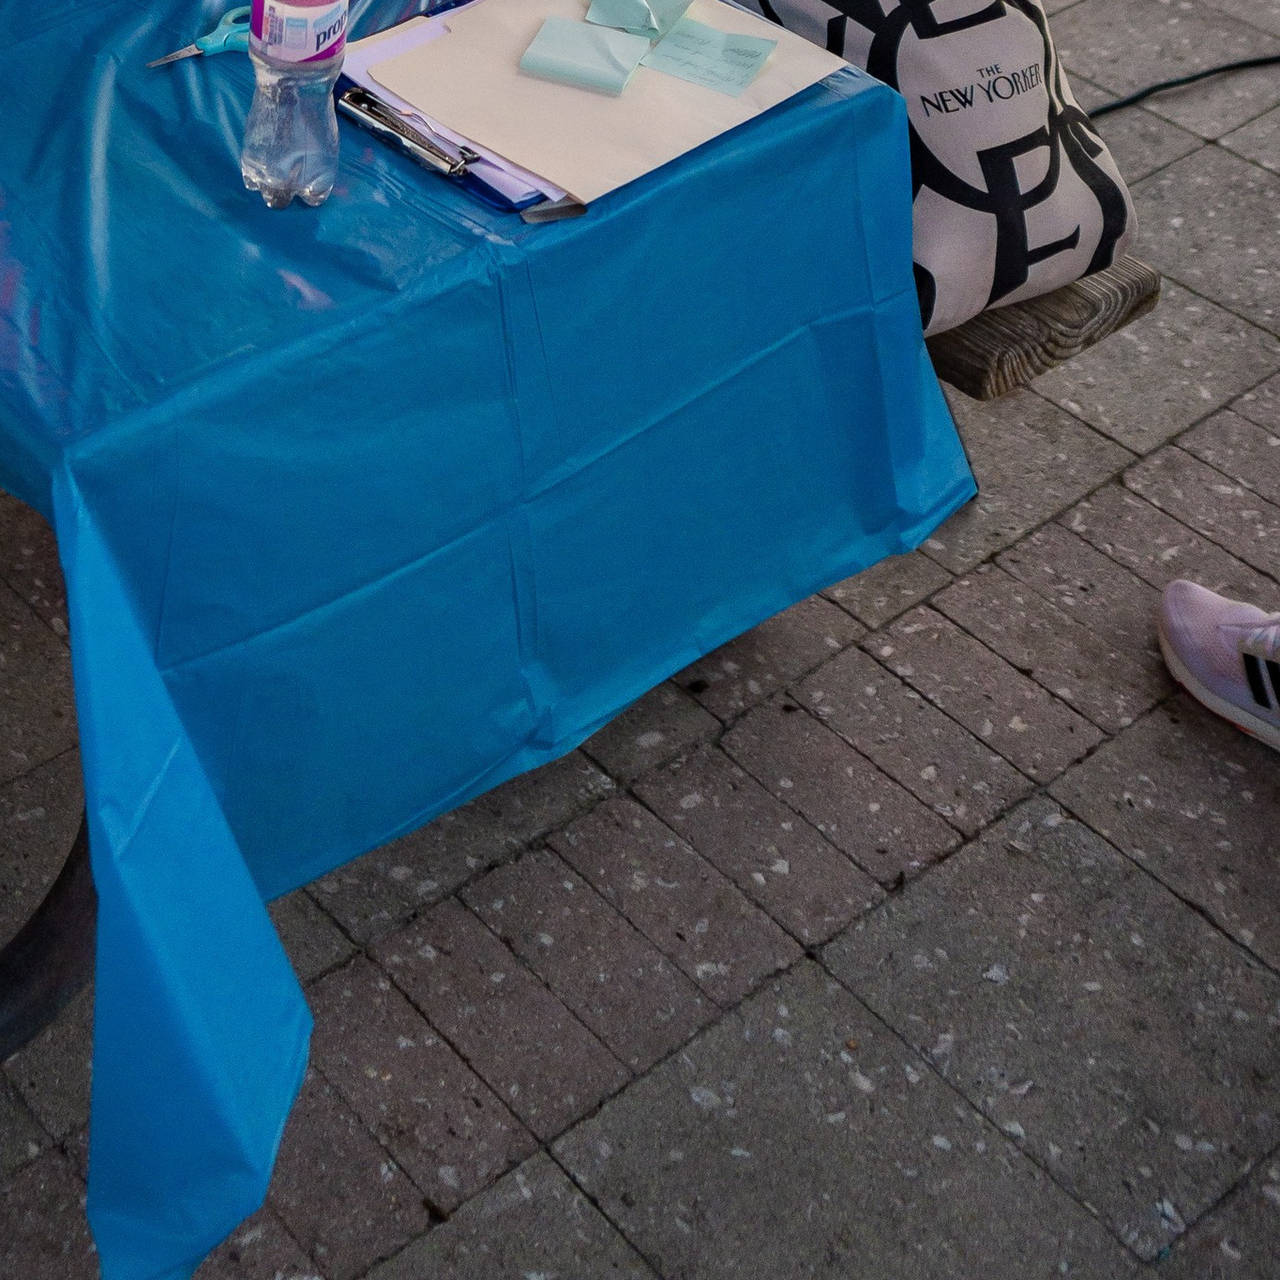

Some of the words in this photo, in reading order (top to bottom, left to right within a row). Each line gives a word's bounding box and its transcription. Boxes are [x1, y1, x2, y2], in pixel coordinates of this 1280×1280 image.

[976, 63, 1003, 79] THE
[920, 84, 974, 118] NEW
[977, 63, 1043, 104] YORKER
